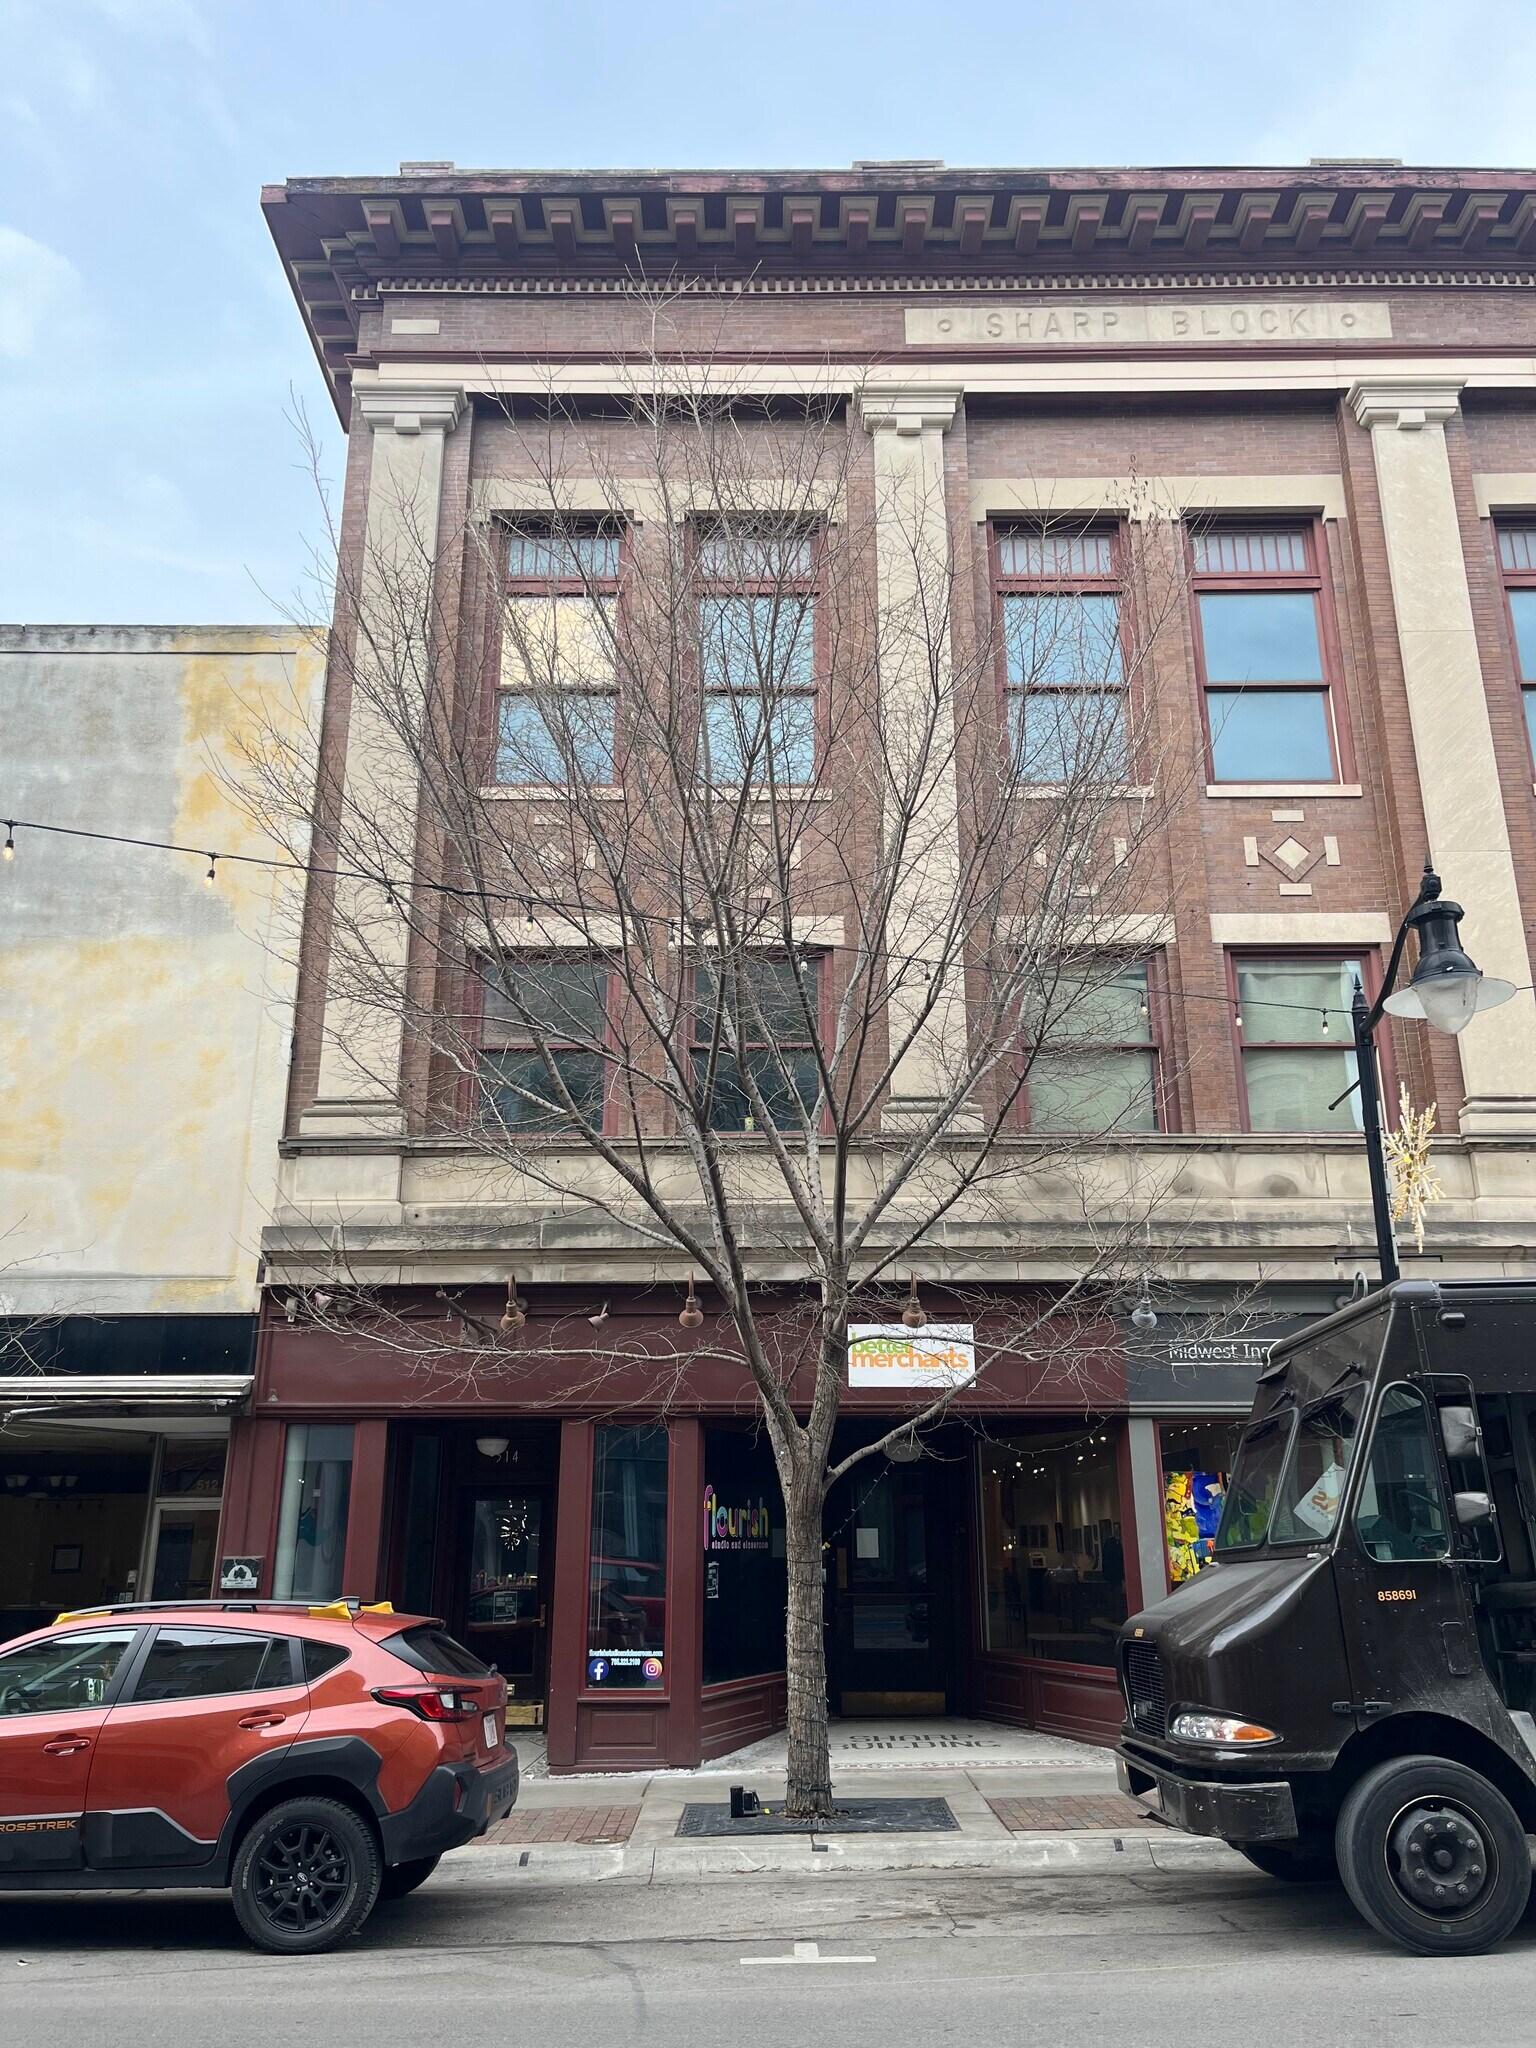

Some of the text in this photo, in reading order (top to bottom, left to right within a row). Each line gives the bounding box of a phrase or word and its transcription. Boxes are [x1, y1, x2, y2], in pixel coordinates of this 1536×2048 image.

[985, 307, 1312, 339] SHARP BLOCK
[851, 1332, 914, 1354] better
[1169, 1343, 1239, 1359] Midwest
[851, 1345, 969, 1369] merchants
[196, 1479, 219, 1490] 512
[703, 1484, 769, 1551] flourish
[1377, 1589, 1417, 1601] 858691
[828, 1740, 1002, 1750] BUILDING
[849, 1734, 974, 1742] SHARP
